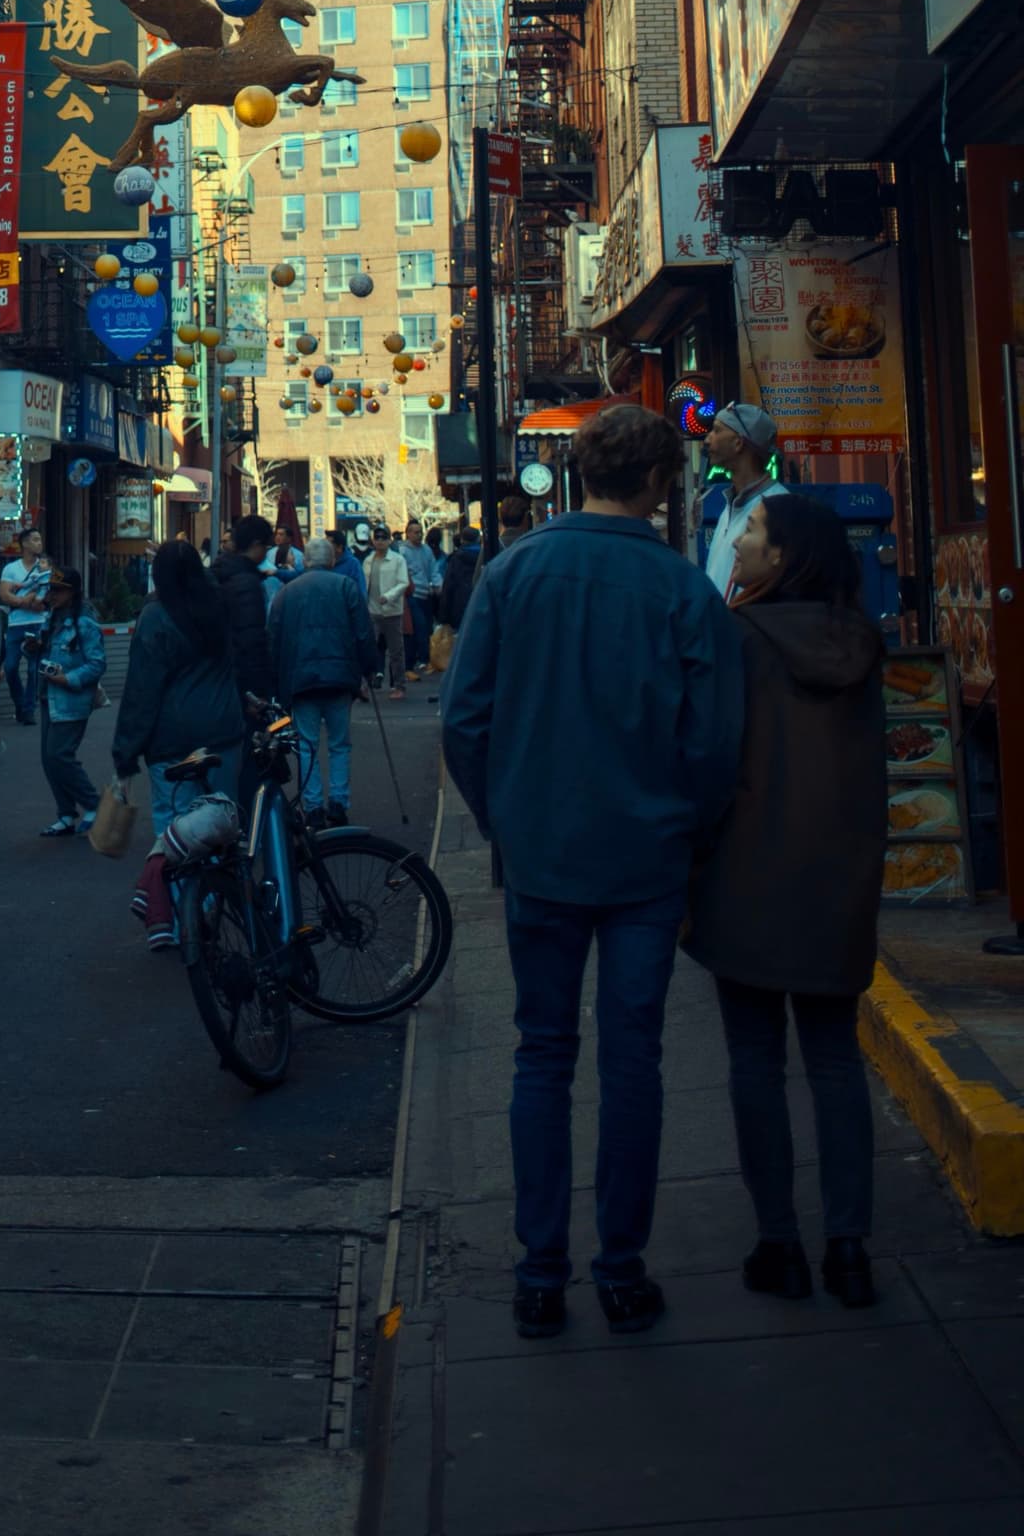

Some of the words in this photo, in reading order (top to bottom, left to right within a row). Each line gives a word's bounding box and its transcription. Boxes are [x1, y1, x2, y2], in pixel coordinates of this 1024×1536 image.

[3, 80, 16, 175] 18Pell.com
[96, 294, 157, 310] OCEAN
[777, 385, 809, 394] moved
[810, 385, 831, 394] from
[845, 384, 868, 394] Mott
[771, 397, 783, 405] 23
[785, 396, 801, 405] Pell
[817, 396, 834, 405] This
[845, 396, 864, 407] only
[867, 397, 884, 405] one
[772, 407, 821, 416] Chinatown
